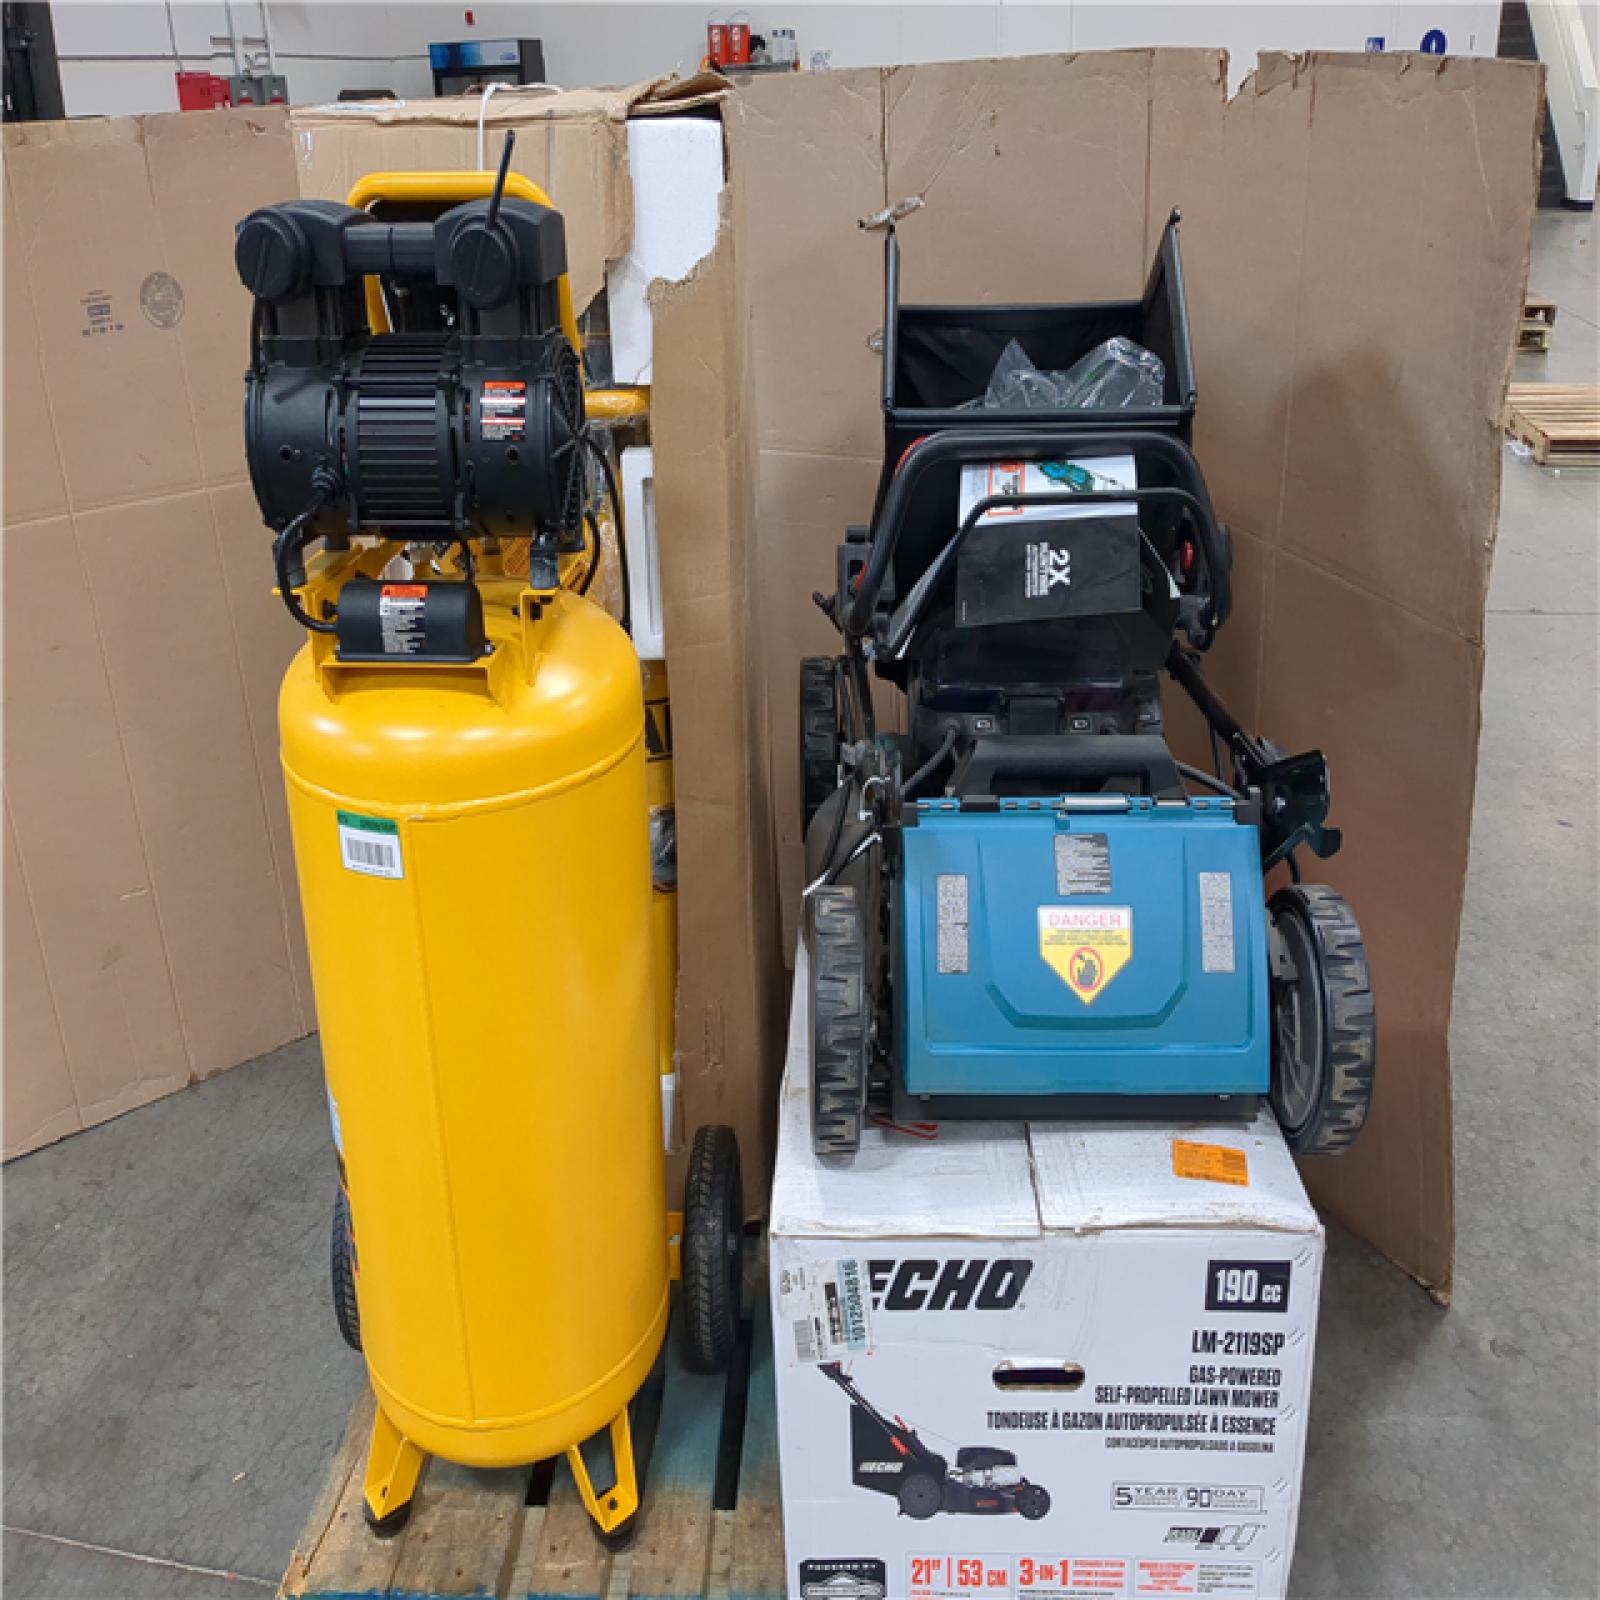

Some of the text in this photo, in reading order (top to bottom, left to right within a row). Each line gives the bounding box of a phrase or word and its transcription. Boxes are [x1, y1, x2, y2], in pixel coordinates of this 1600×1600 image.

[1049, 549, 1071, 586] 2X
[1048, 910, 1121, 929] DANGER
[1216, 1269, 1259, 1304] 190
[1192, 1330, 1286, 1356] LM-2119SP
[1190, 1365, 1281, 1386] GAS-POWERED
[1095, 1385, 1279, 1408] SELF-PROPELLED LAWN MOWER
[987, 1411, 1048, 1430] TONDEUSE
[1062, 1411, 1103, 1431] GAZON
[1222, 1416, 1276, 1436] ESSENCE
[1116, 1486, 1133, 1506] 5
[1135, 1487, 1178, 1496] YEAR
[1187, 1488, 1211, 1508] 90
[1214, 1489, 1248, 1497] DAY
[911, 1558, 1008, 1588] 21" 53 CM
[1019, 1558, 1069, 1586] 3-IN-1
